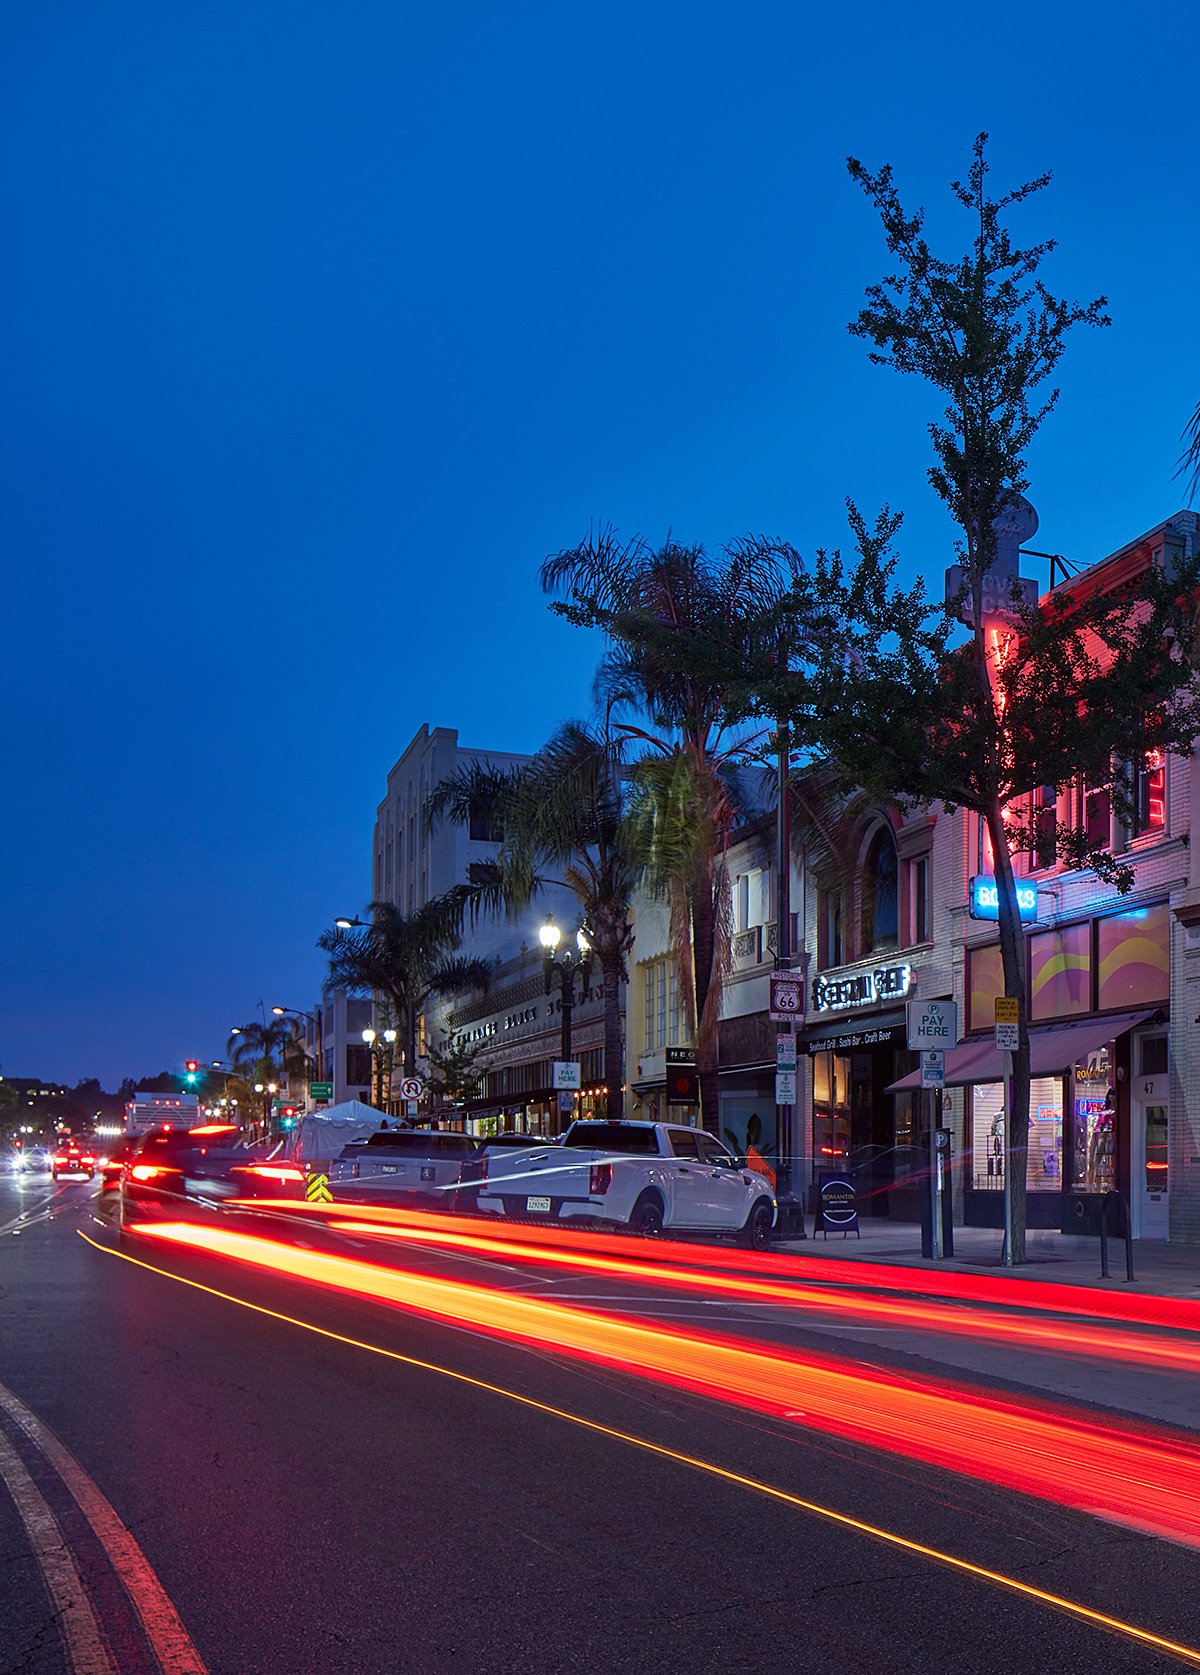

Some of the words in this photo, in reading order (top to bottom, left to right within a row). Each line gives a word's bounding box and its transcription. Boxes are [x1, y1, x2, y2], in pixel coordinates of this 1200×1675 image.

[774, 972, 800, 980] HISTORIC
[780, 997, 795, 1008] 66
[922, 1015, 945, 1025] PAY
[917, 1026, 949, 1037] HERE
[809, 1040, 826, 1052] Seafood
[827, 1039, 836, 1049] Grill
[839, 1037, 852, 1048] Sushi
[852, 1035, 861, 1045] Bar
[864, 1031, 878, 1043] Craft
[878, 1030, 891, 1042] Beer
[1143, 1081, 1154, 1094] 47
